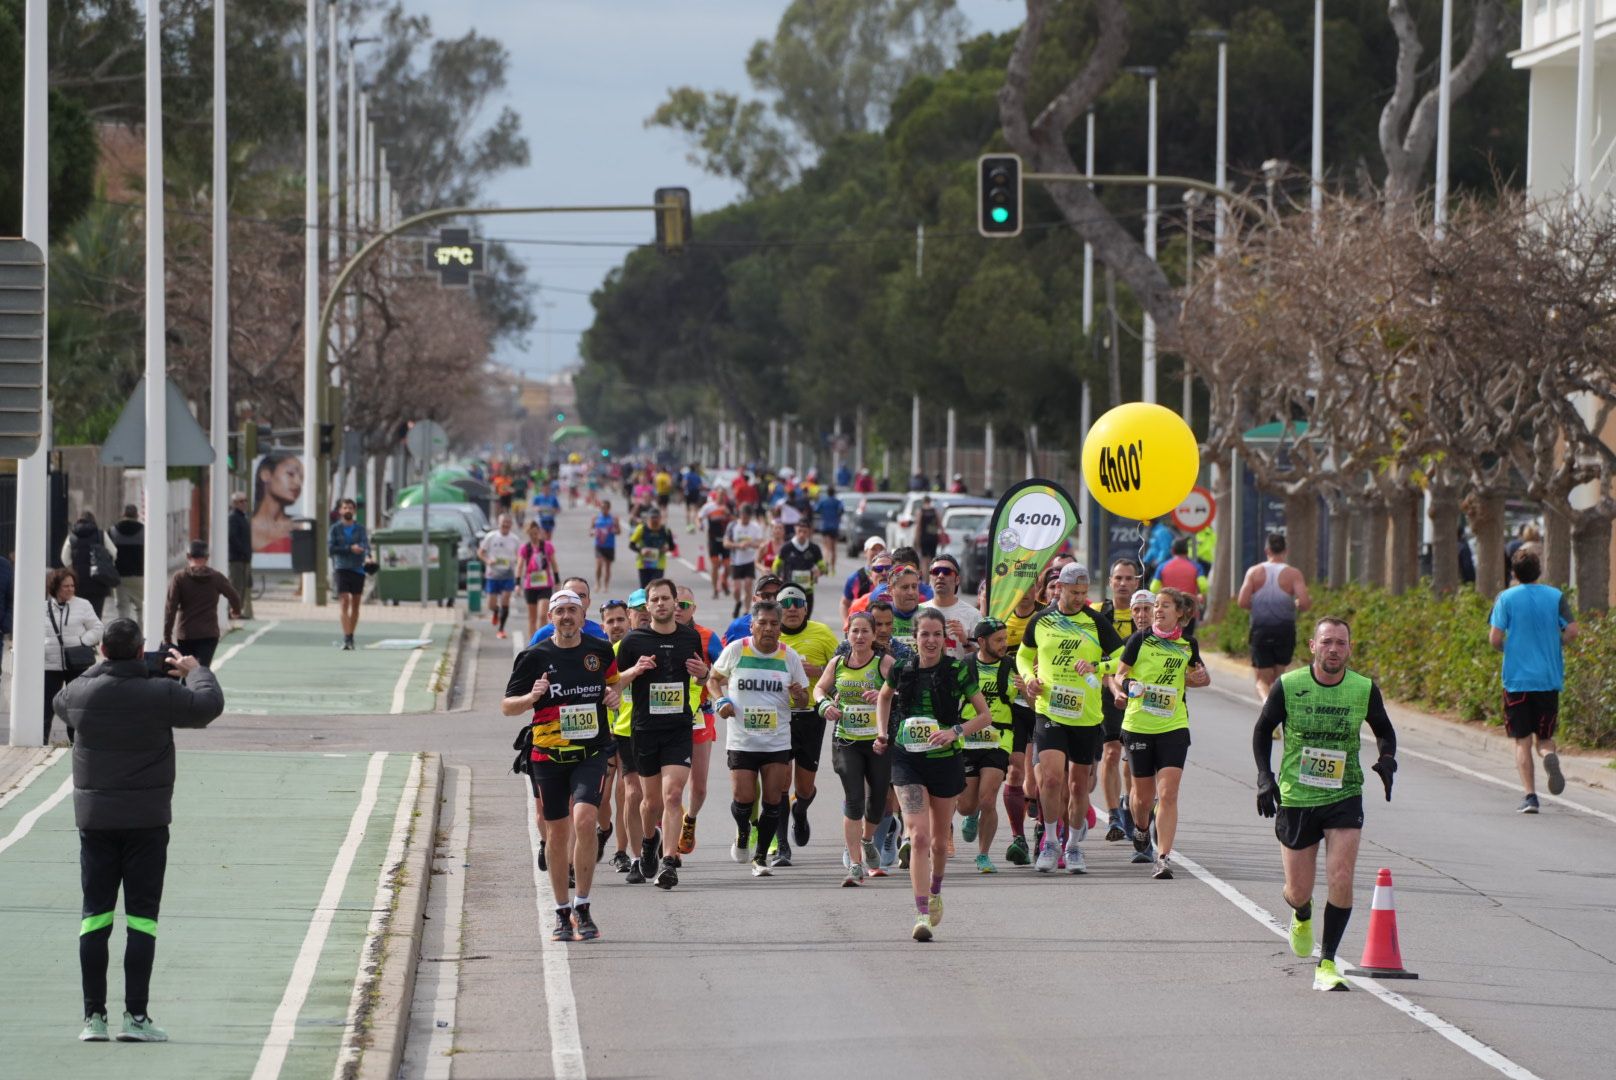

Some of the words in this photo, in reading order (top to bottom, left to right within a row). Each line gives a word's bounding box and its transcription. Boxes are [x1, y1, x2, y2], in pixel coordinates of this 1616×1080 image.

[1014, 513, 1061, 526] 4:00h
[1058, 640, 1081, 650] RUN
[1052, 656, 1074, 666] LIFE
[1163, 658, 1184, 668] RUN
[738, 679, 783, 692] BOLIVIA
[1155, 675, 1177, 685] LIFE
[549, 683, 602, 699] Runbeers
[654, 691, 680, 702] 1022
[1056, 693, 1077, 707] 966
[1150, 693, 1170, 706] 915
[565, 713, 593, 727] 1130
[750, 713, 770, 725] 972
[849, 713, 870, 724] 943
[909, 726, 931, 739] 628
[1310, 758, 1336, 774] 795
[1308, 771, 1334, 779] ALBERTO
